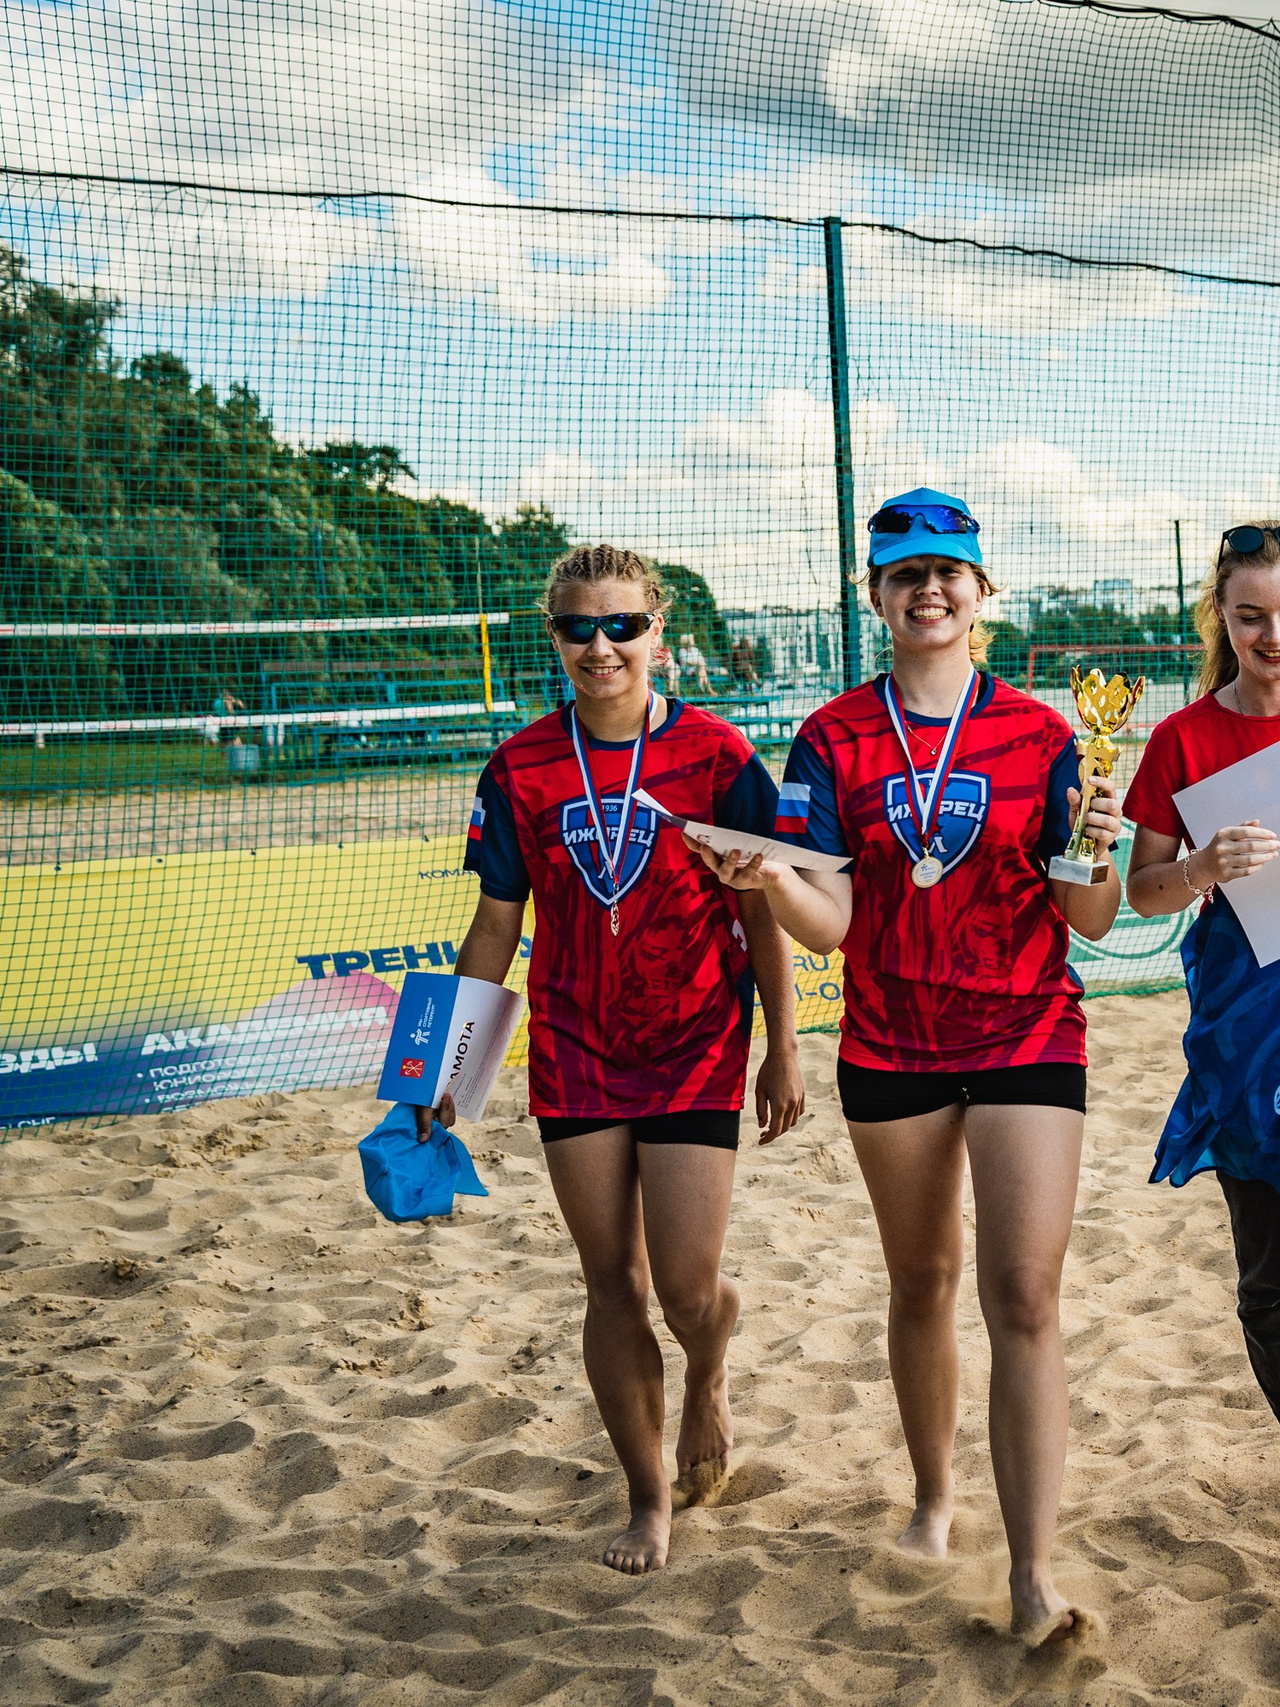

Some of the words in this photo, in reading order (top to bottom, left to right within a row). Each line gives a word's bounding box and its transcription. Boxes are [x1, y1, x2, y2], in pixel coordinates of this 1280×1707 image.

[887, 800, 986, 822] ИЖРЕЦ
[563, 826, 655, 846] ИЖРЕЦ
[419, 868, 478, 880] КОМА
[141, 1006, 389, 1055] АКАДЕМИЯ
[449, 1020, 475, 1081] АМОТА
